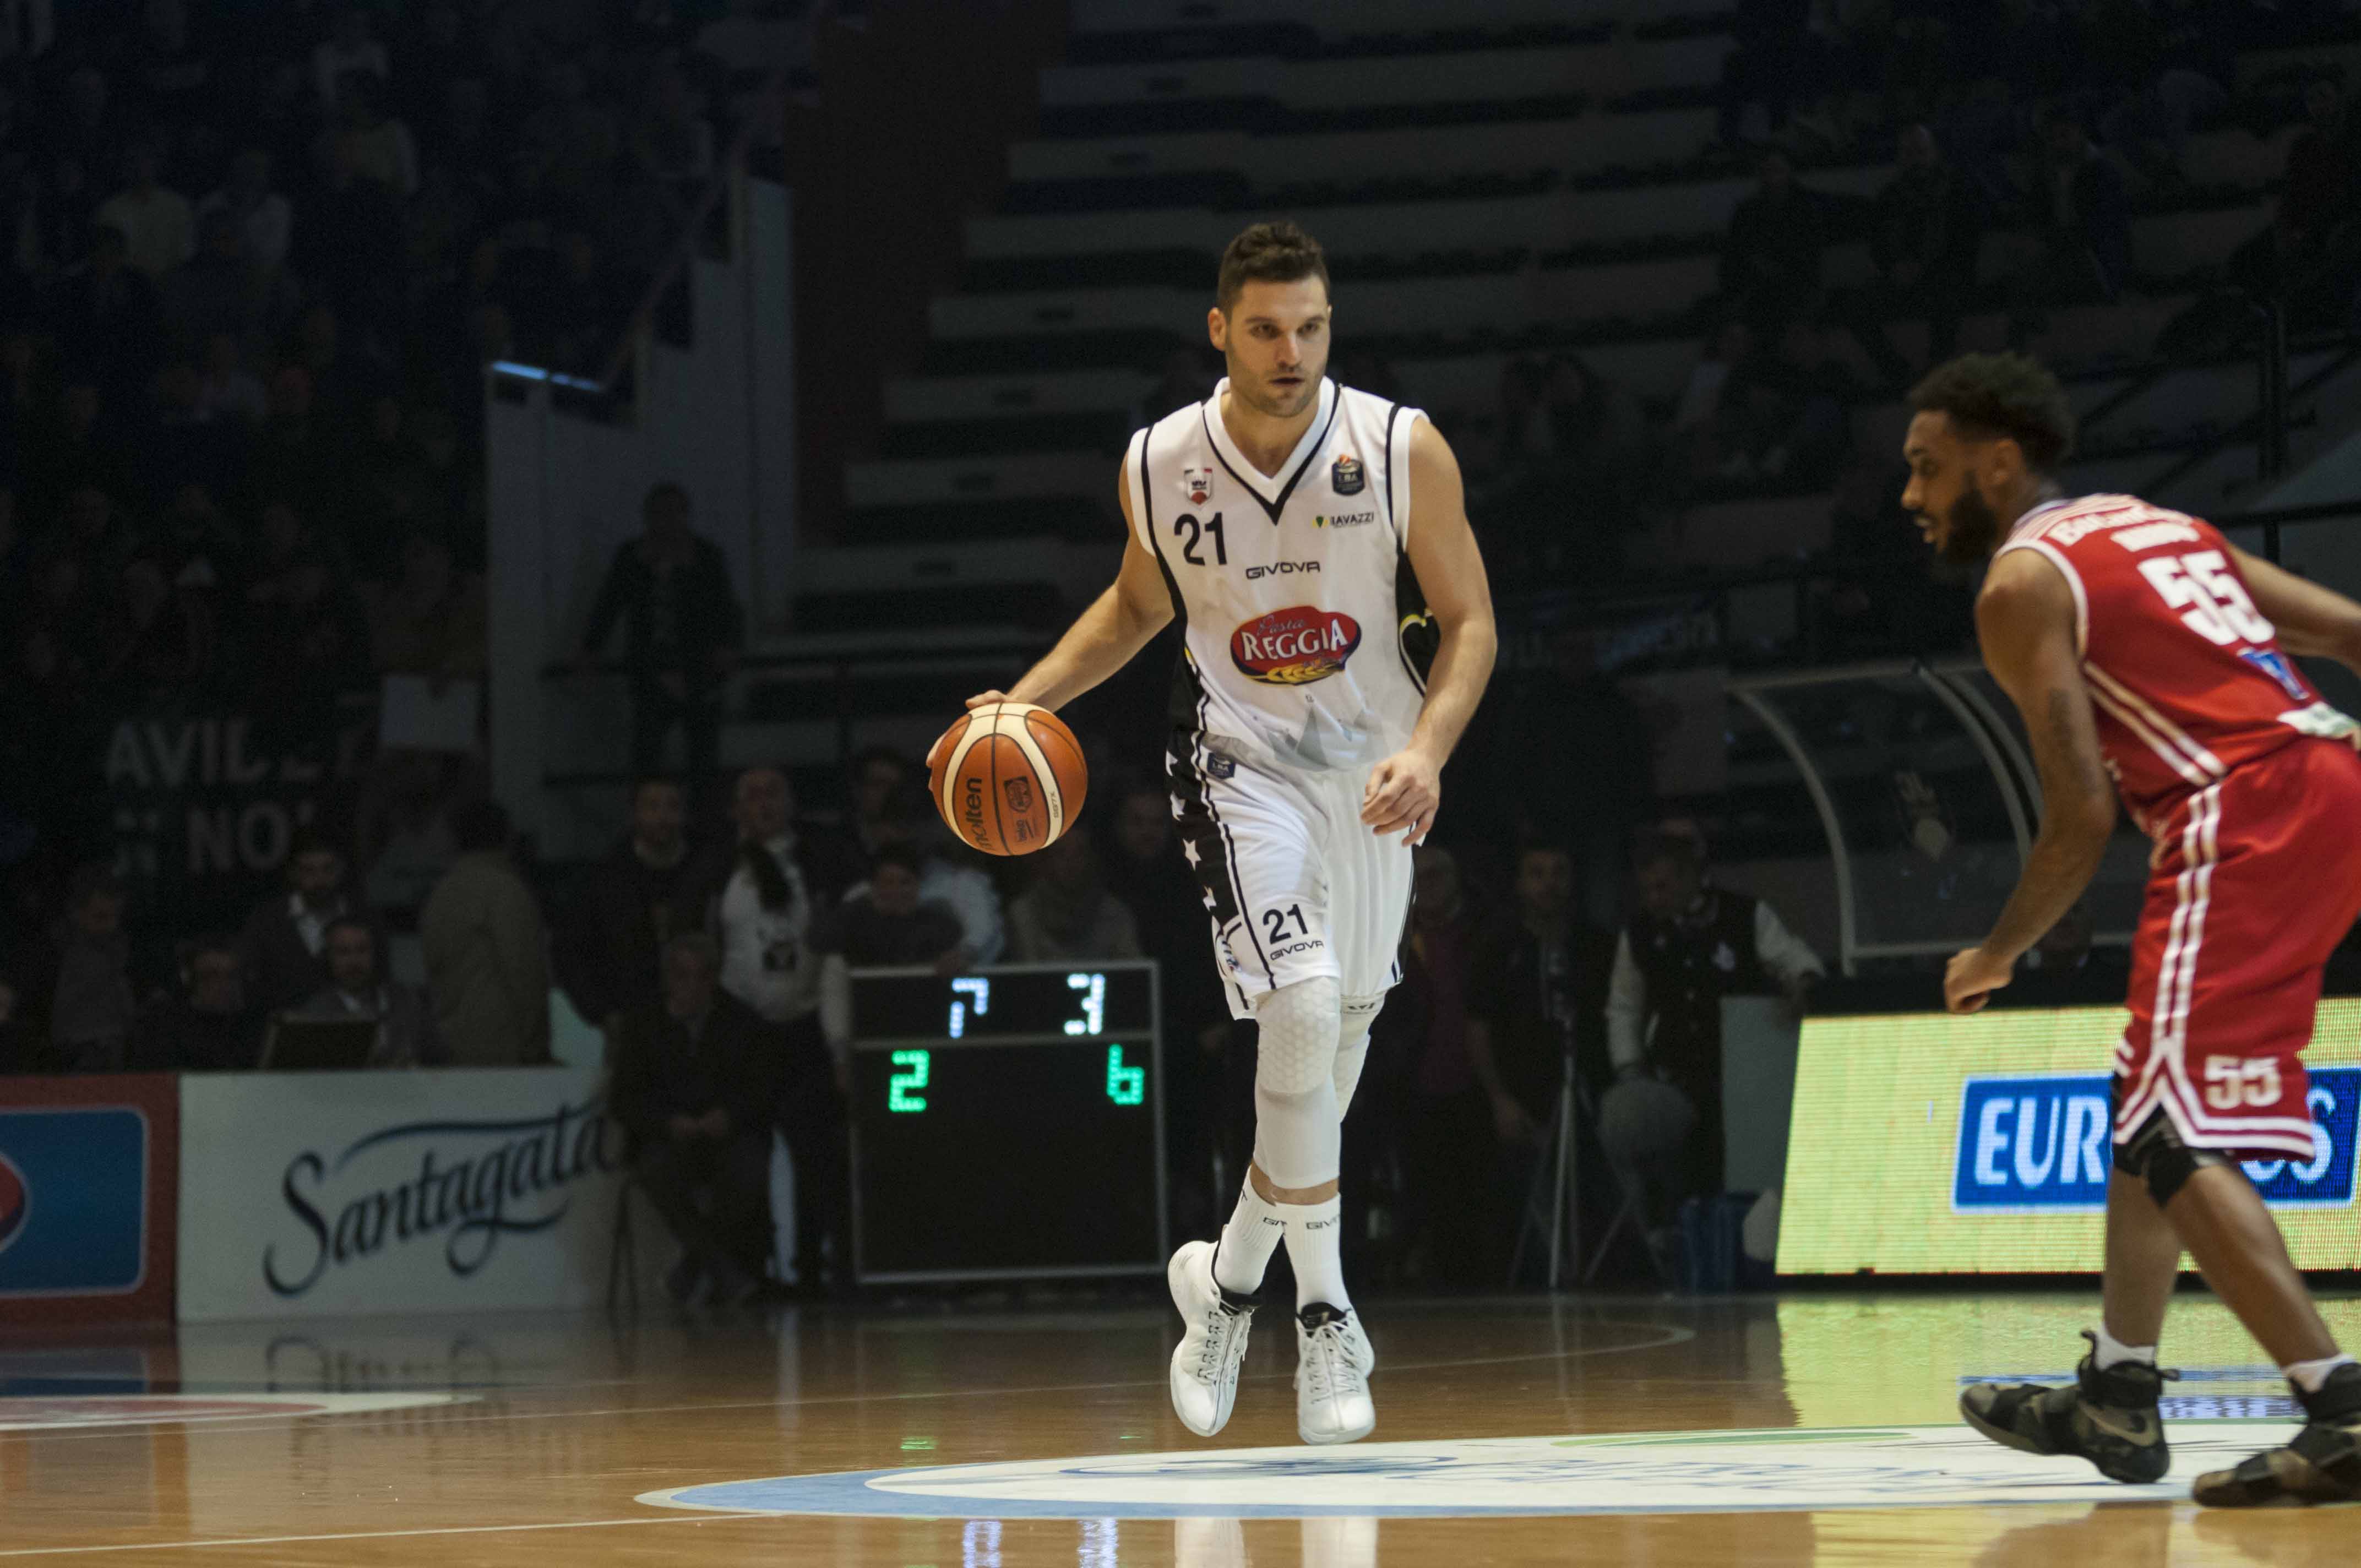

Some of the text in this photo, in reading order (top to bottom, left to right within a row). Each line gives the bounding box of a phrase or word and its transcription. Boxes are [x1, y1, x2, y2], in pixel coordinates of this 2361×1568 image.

[1174, 511, 1227, 566] 21
[1245, 561, 1320, 580] GIVOVA
[2137, 551, 2275, 645] 55
[1241, 618, 1348, 661] REGGIA
[1258, 614, 1305, 636] Pasta
[965, 777, 994, 850] molten
[1263, 903, 1308, 945] 21
[1270, 940, 1324, 961] GIVOVA
[1064, 972, 1106, 1035] 3
[888, 1049, 931, 1113] 2
[2204, 1053, 2283, 1110] 55
[263, 1103, 618, 1298] Santagata
